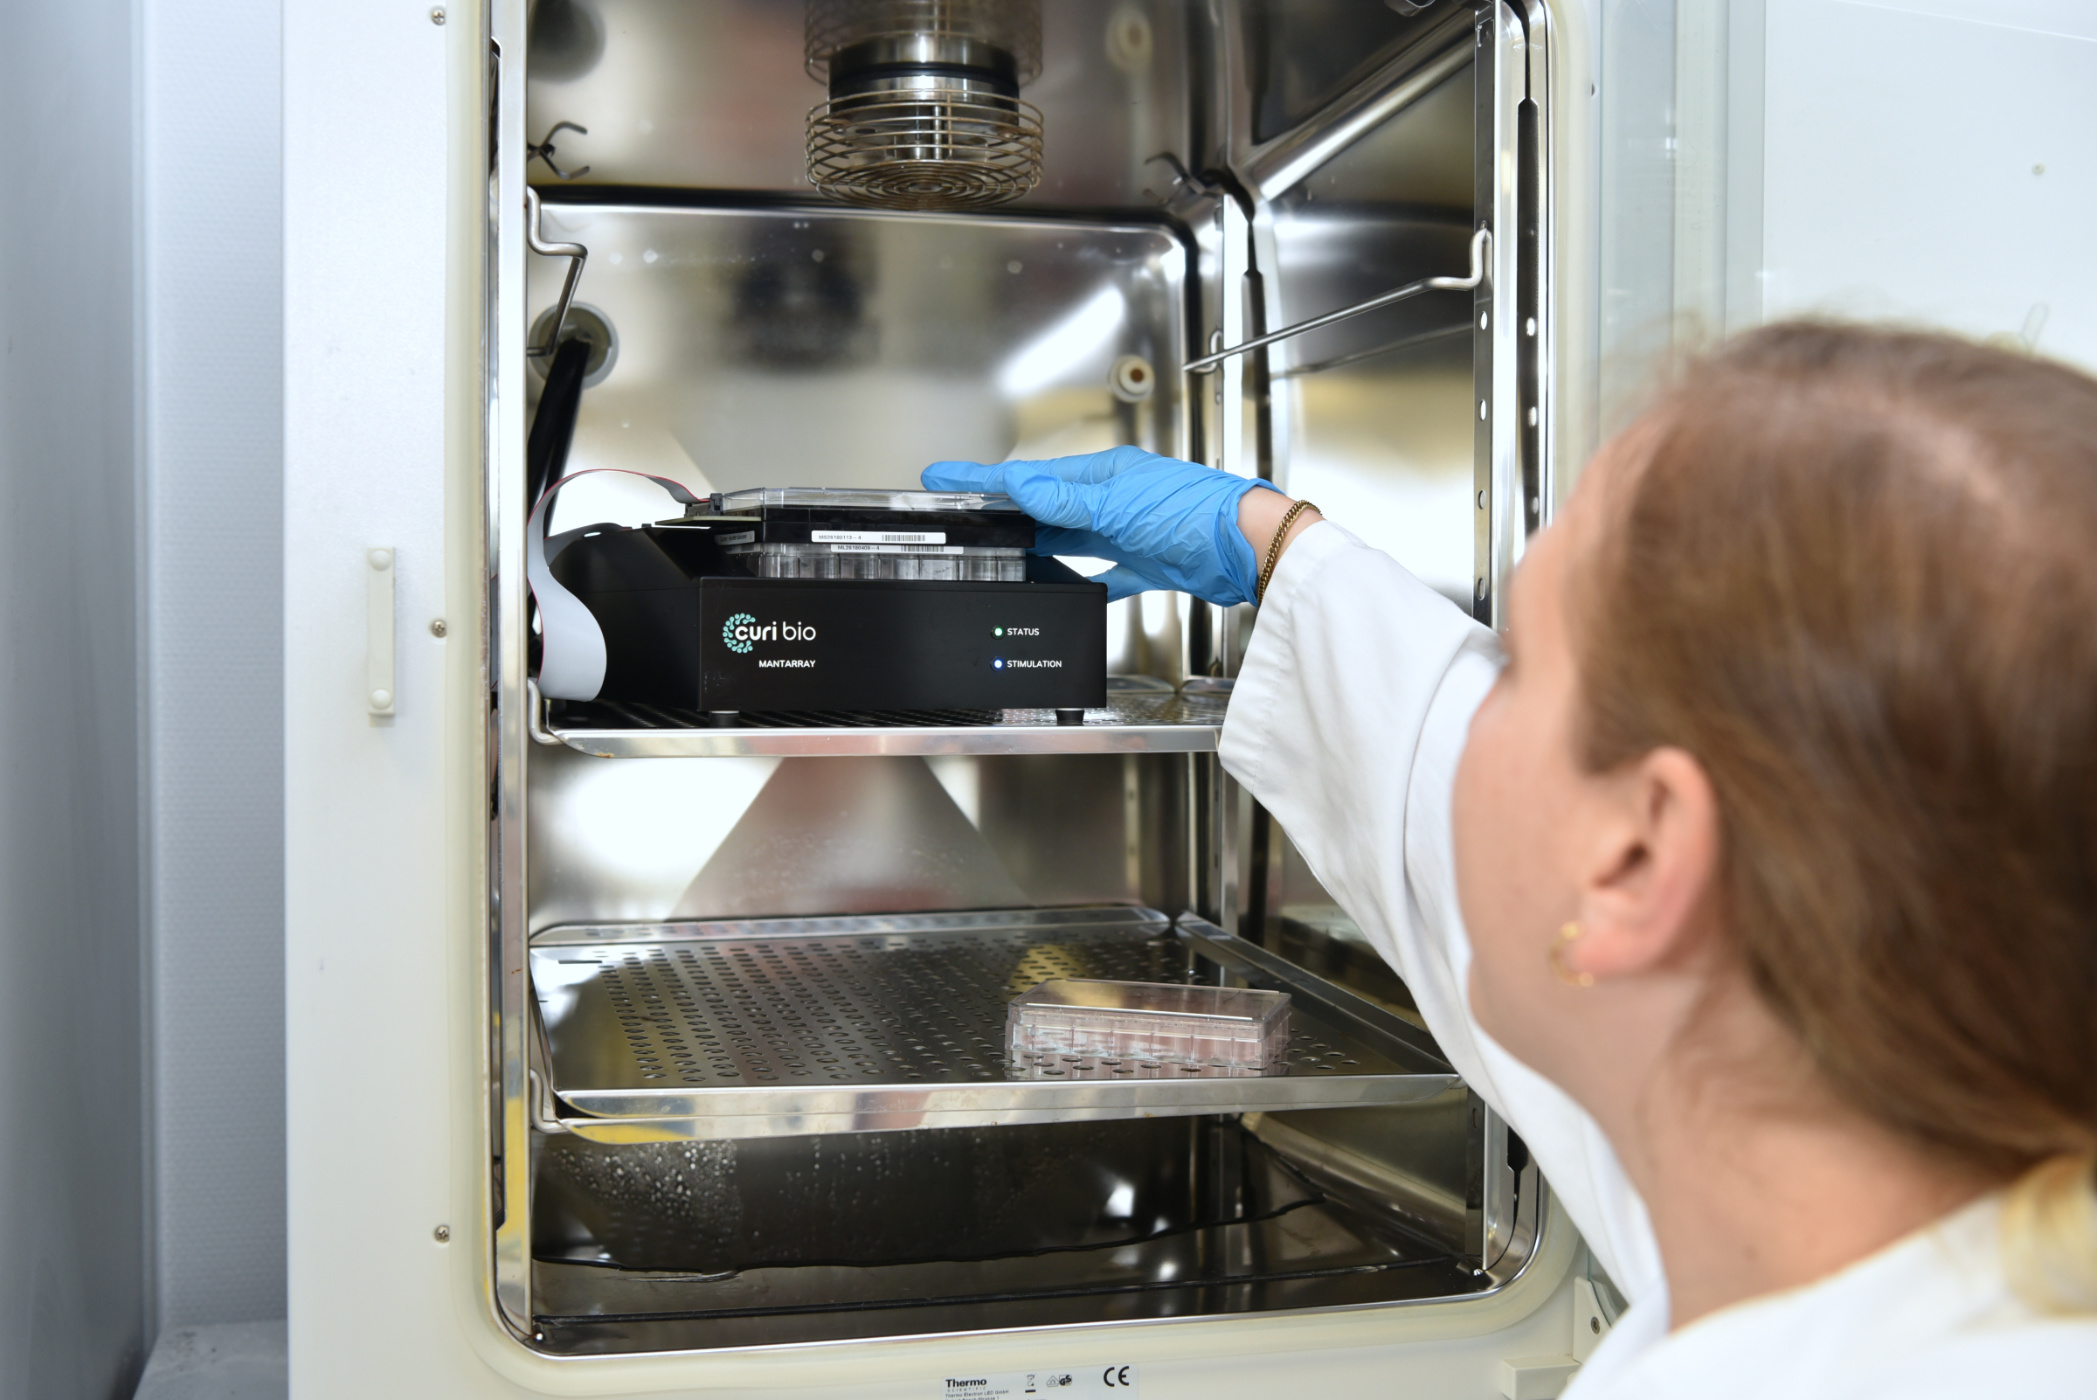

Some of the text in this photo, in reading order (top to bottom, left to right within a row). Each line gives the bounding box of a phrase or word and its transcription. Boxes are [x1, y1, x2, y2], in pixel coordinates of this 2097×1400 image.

[735, 621, 817, 641] curi bio
[1007, 627, 1040, 636] STATUS
[758, 660, 816, 668] MANTARRAY
[1007, 660, 1062, 668] STIMULATION
[1103, 1366, 1130, 1387] CE
[945, 1379, 987, 1388] Thermo
